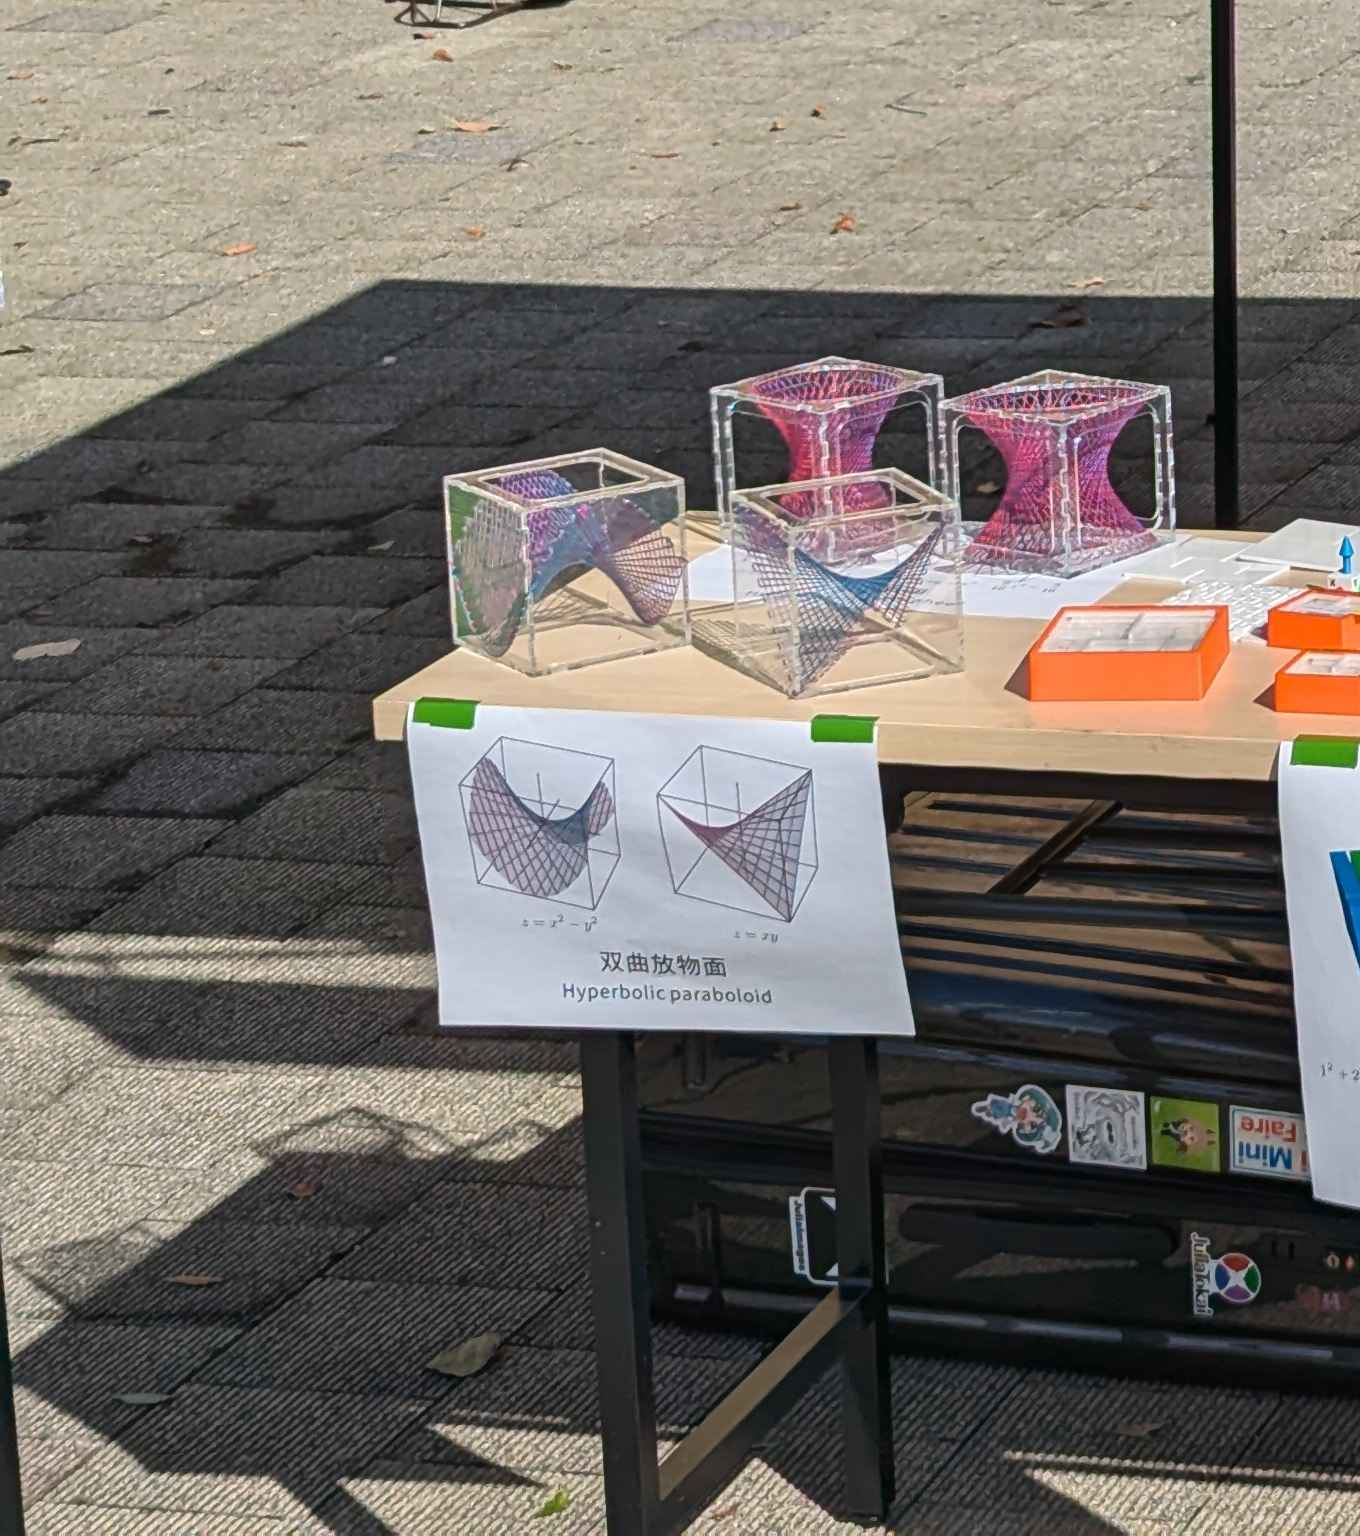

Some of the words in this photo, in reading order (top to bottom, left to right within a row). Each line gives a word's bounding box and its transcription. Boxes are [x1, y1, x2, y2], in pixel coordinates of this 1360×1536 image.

[600, 951, 727, 977] 双曲放物面
[562, 982, 665, 1003] Hyperbolic
[670, 986, 773, 1004] paraboloid
[1240, 1115, 1298, 1144] Faire
[1238, 1140, 1293, 1170] Mini
